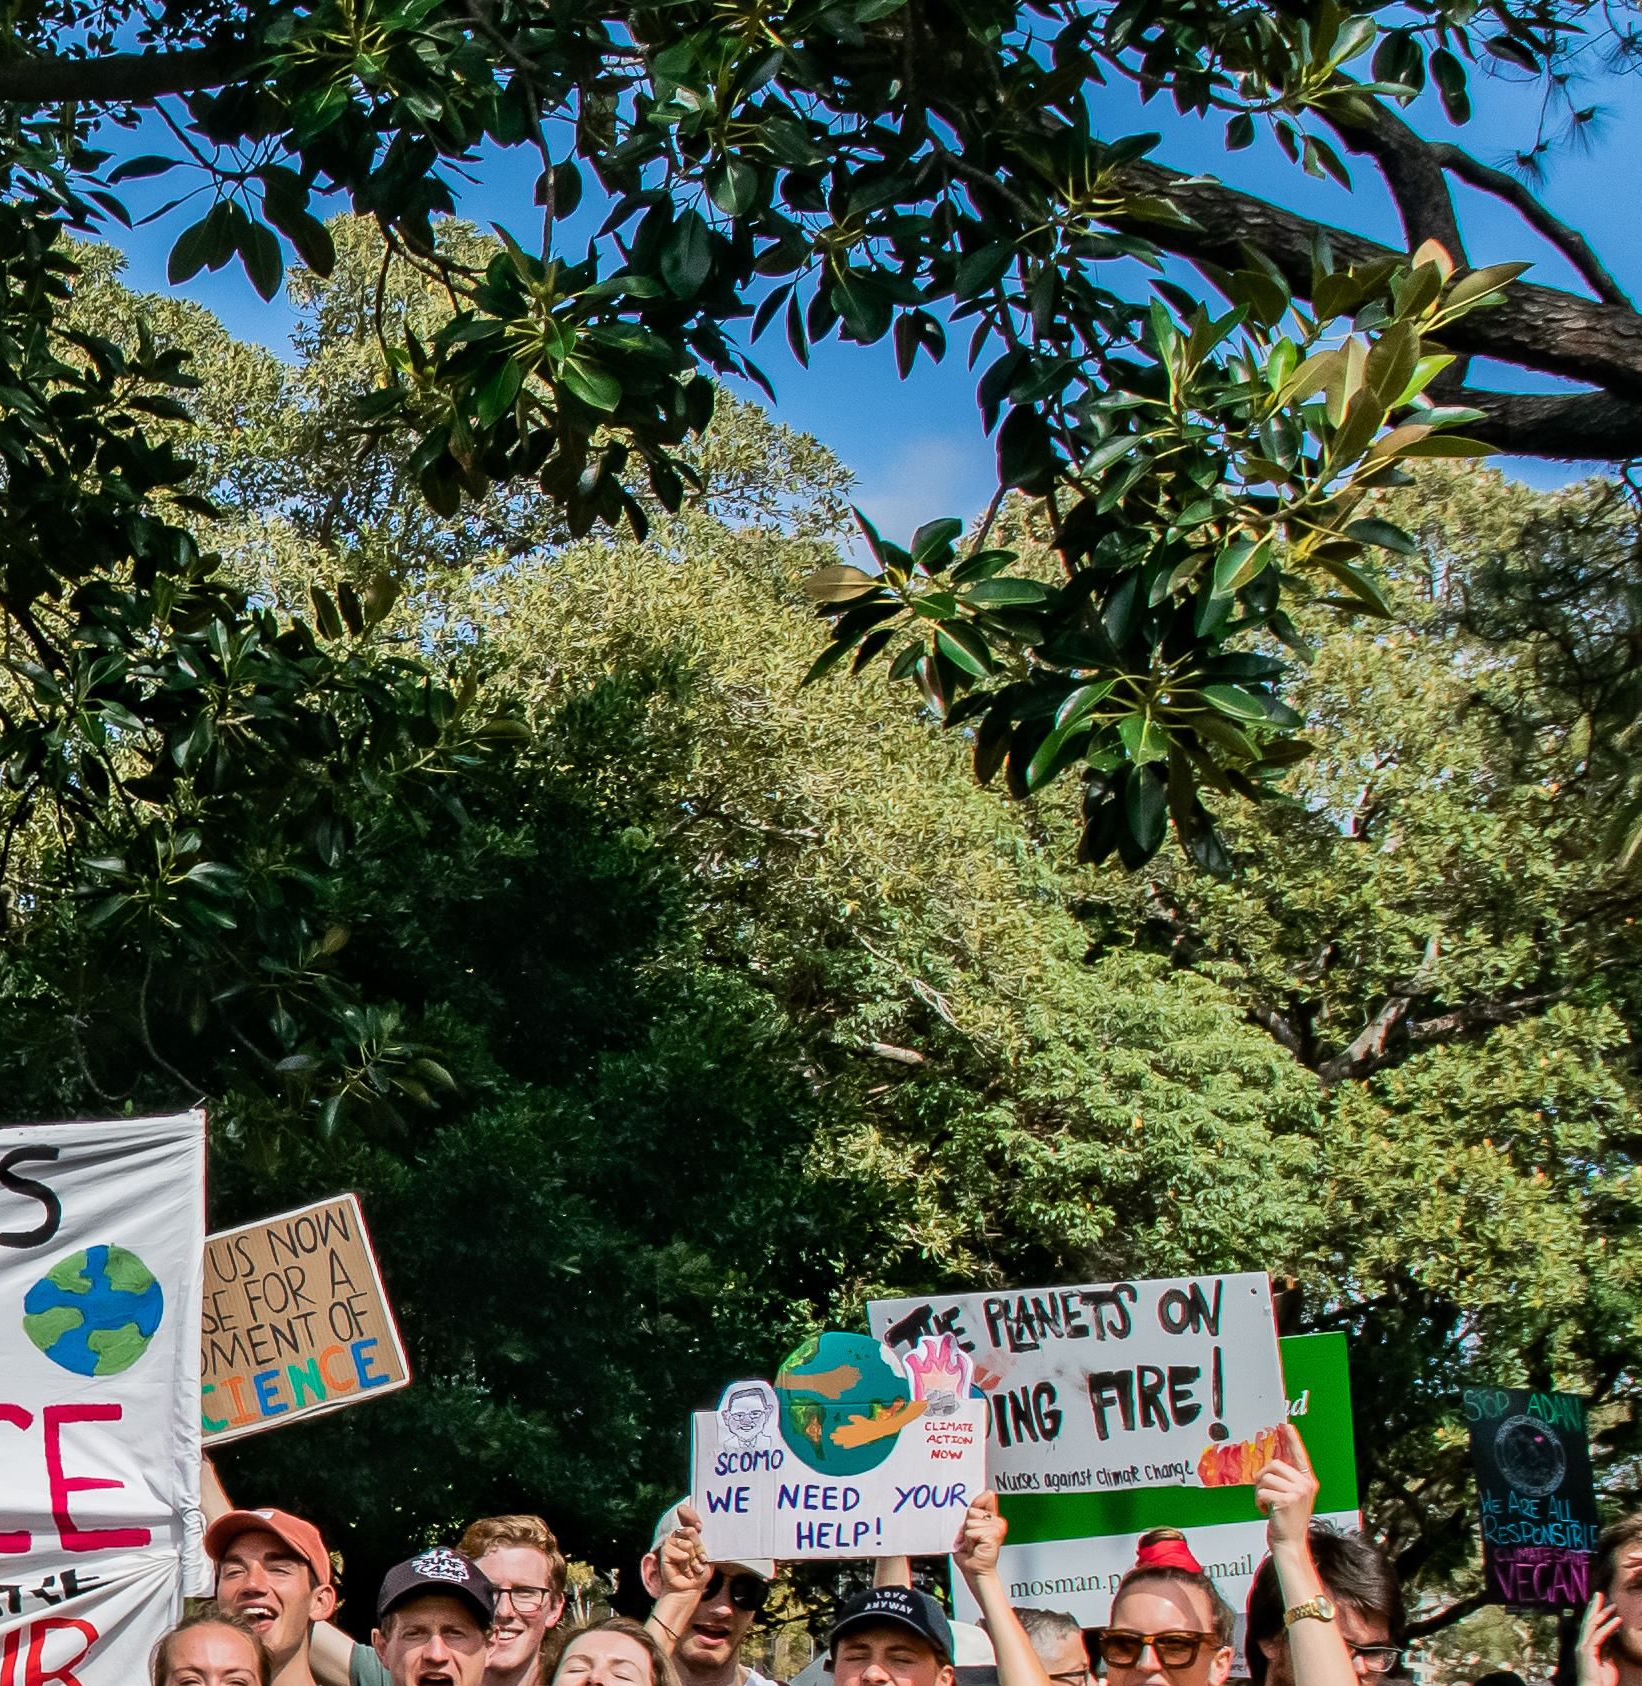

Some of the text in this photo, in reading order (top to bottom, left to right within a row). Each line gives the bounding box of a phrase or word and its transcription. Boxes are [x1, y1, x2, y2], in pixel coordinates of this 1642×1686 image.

[209, 1207, 350, 1283] US NOW
[243, 1266, 317, 1322] FOR
[328, 1247, 357, 1299] A
[328, 1291, 368, 1342] OF
[1158, 1278, 1223, 1338] ON
[201, 1337, 390, 1432] CIENCE
[1088, 1345, 1231, 1442] FIRE!
[924, 1421, 974, 1433] CLIMATE
[926, 1434, 974, 1446] ACTION
[715, 1449, 784, 1477] SCOMO
[930, 1450, 963, 1461] NOW
[995, 1471, 1040, 1491] Nurses
[1043, 1468, 1092, 1493] against
[706, 1483, 970, 1514] WE NEED YOUR
[1508, 1490, 1542, 1519] ARE
[1547, 1495, 1579, 1523] ALL
[795, 1517, 882, 1551] HELP!
[875, 1591, 908, 1601] LOVE
[1494, 1562, 1589, 1603] VEGAN
[864, 1600, 913, 1614] ANYWAY
